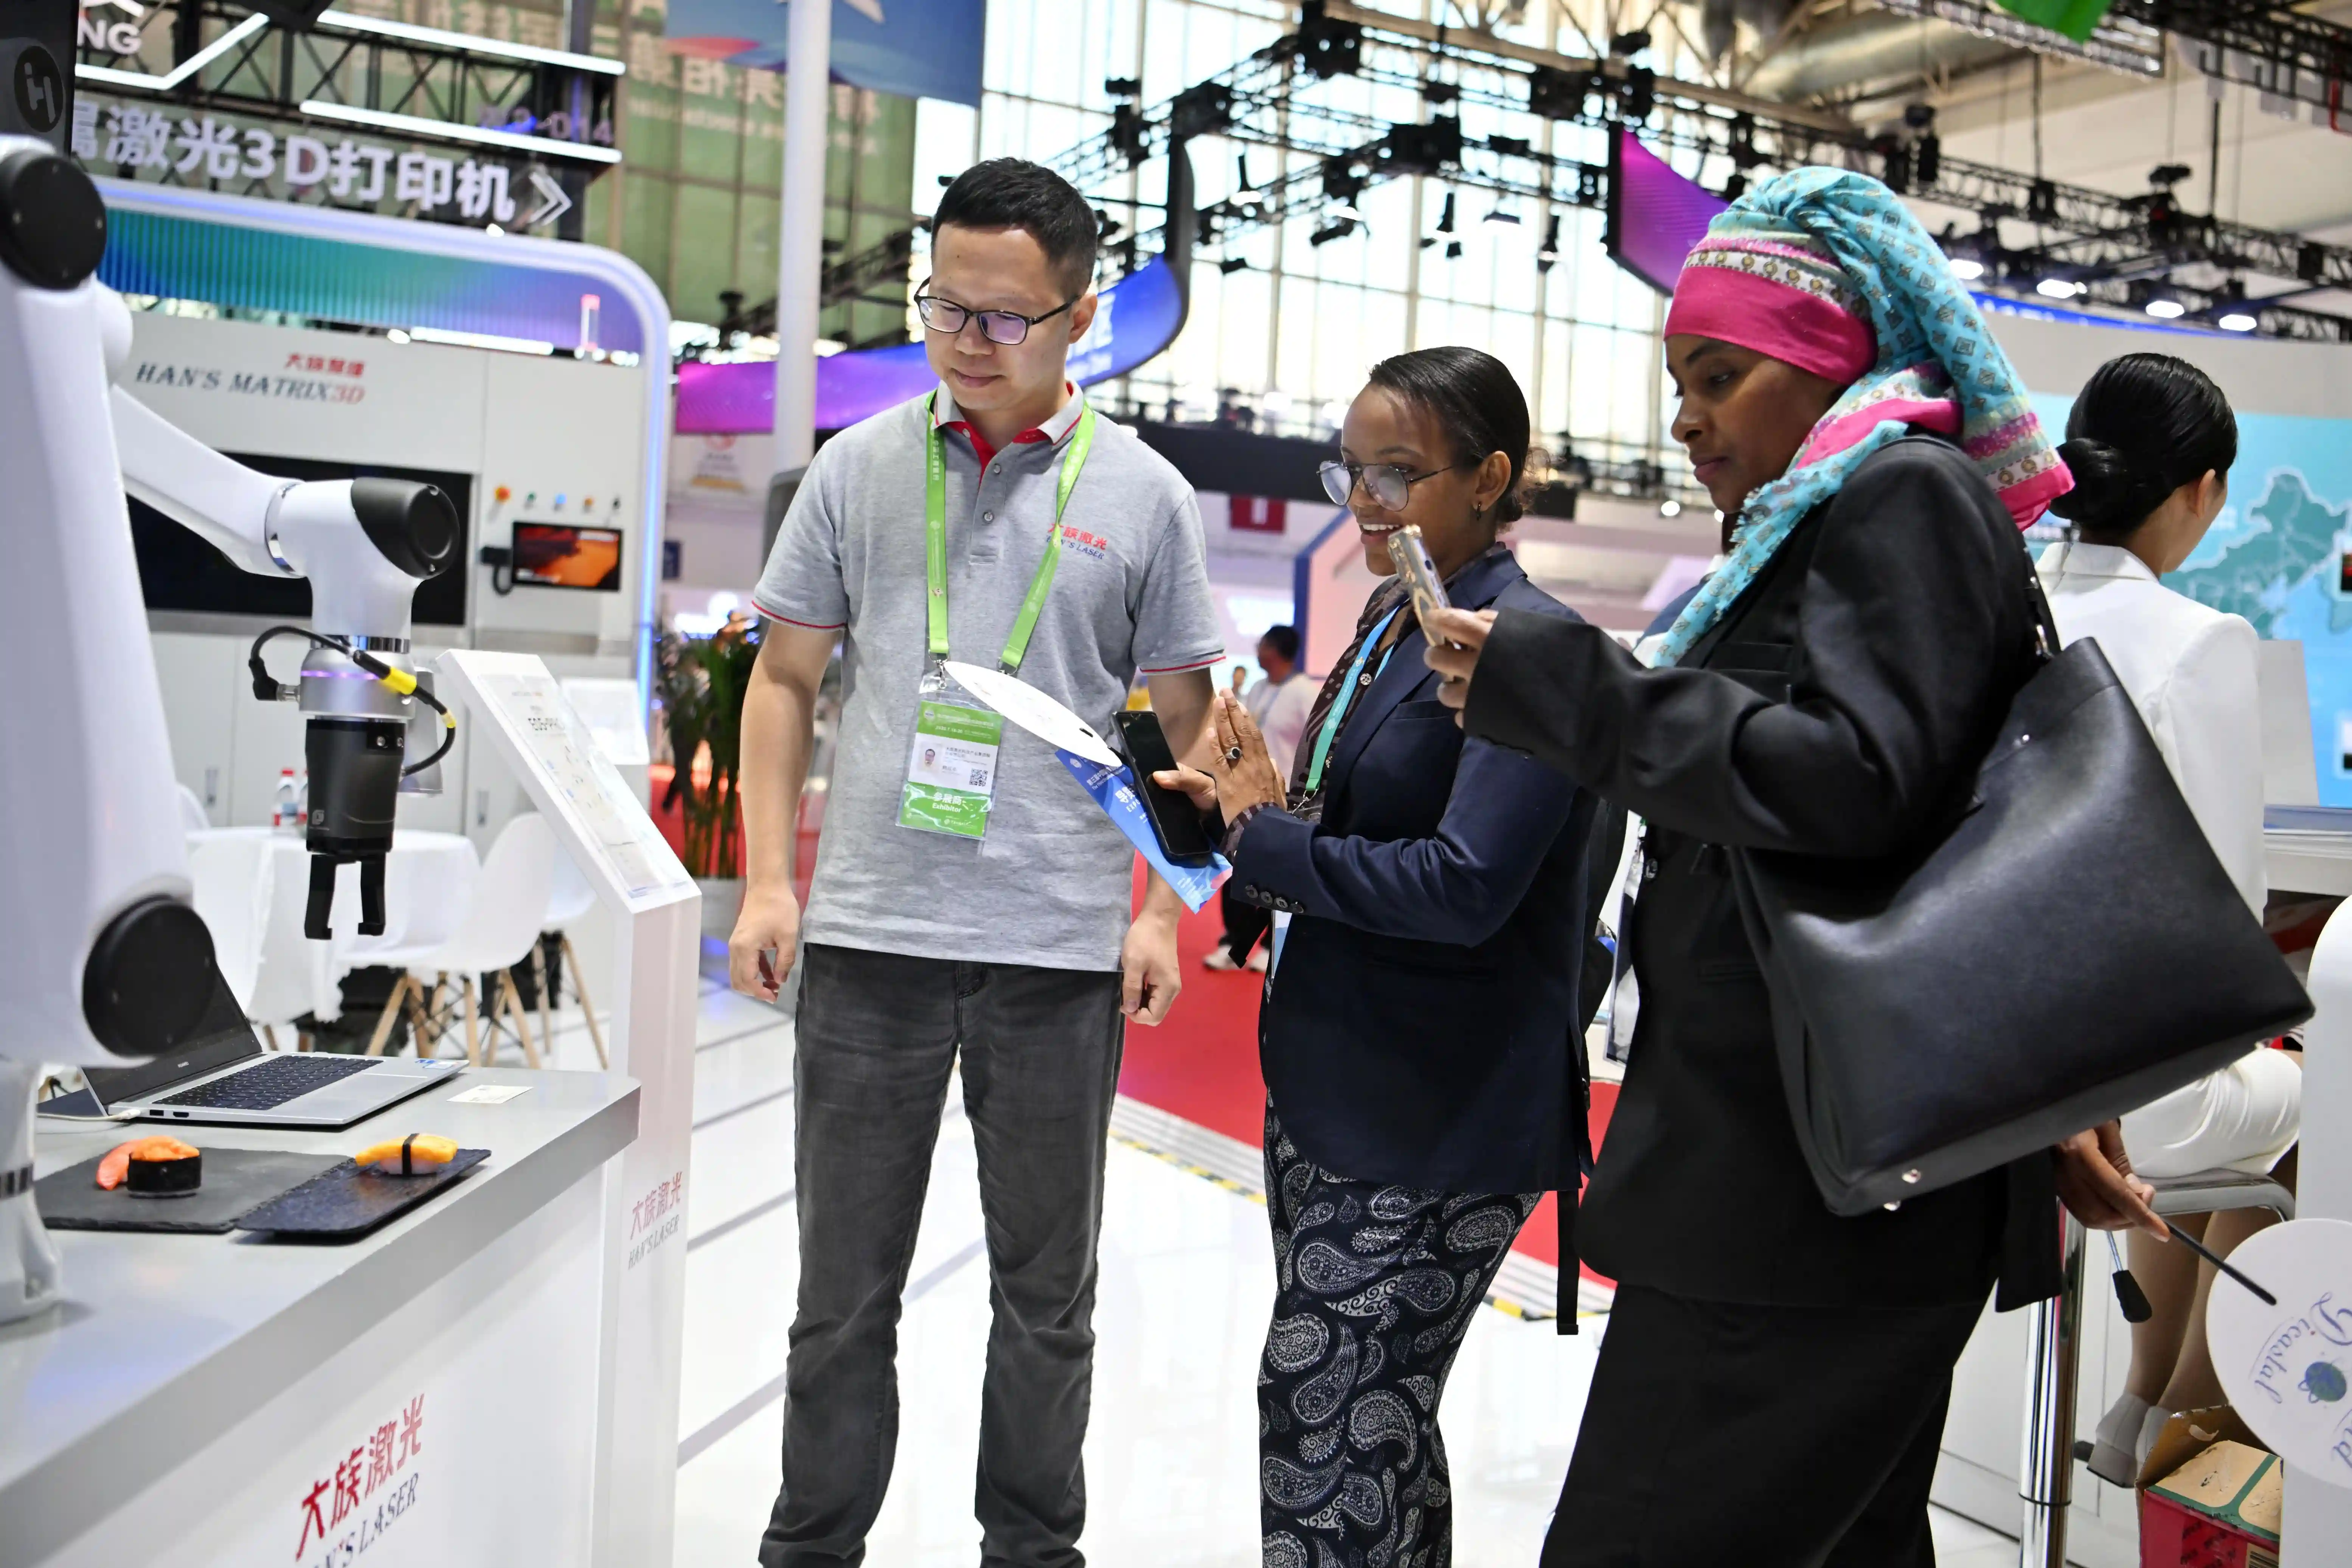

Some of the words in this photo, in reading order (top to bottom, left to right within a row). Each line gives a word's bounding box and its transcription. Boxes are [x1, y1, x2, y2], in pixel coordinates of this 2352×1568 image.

[135, 362, 222, 391] HAN'S
[1076, 545, 1105, 559] LASER
[932, 802, 962, 813] Exhibitor
[933, 792, 962, 806] 参展商
[630, 1172, 682, 1241] 大族激光
[654, 1214, 680, 1250] LASER
[295, 1393, 425, 1562] 大族激光
[359, 1472, 419, 1554] LASER
